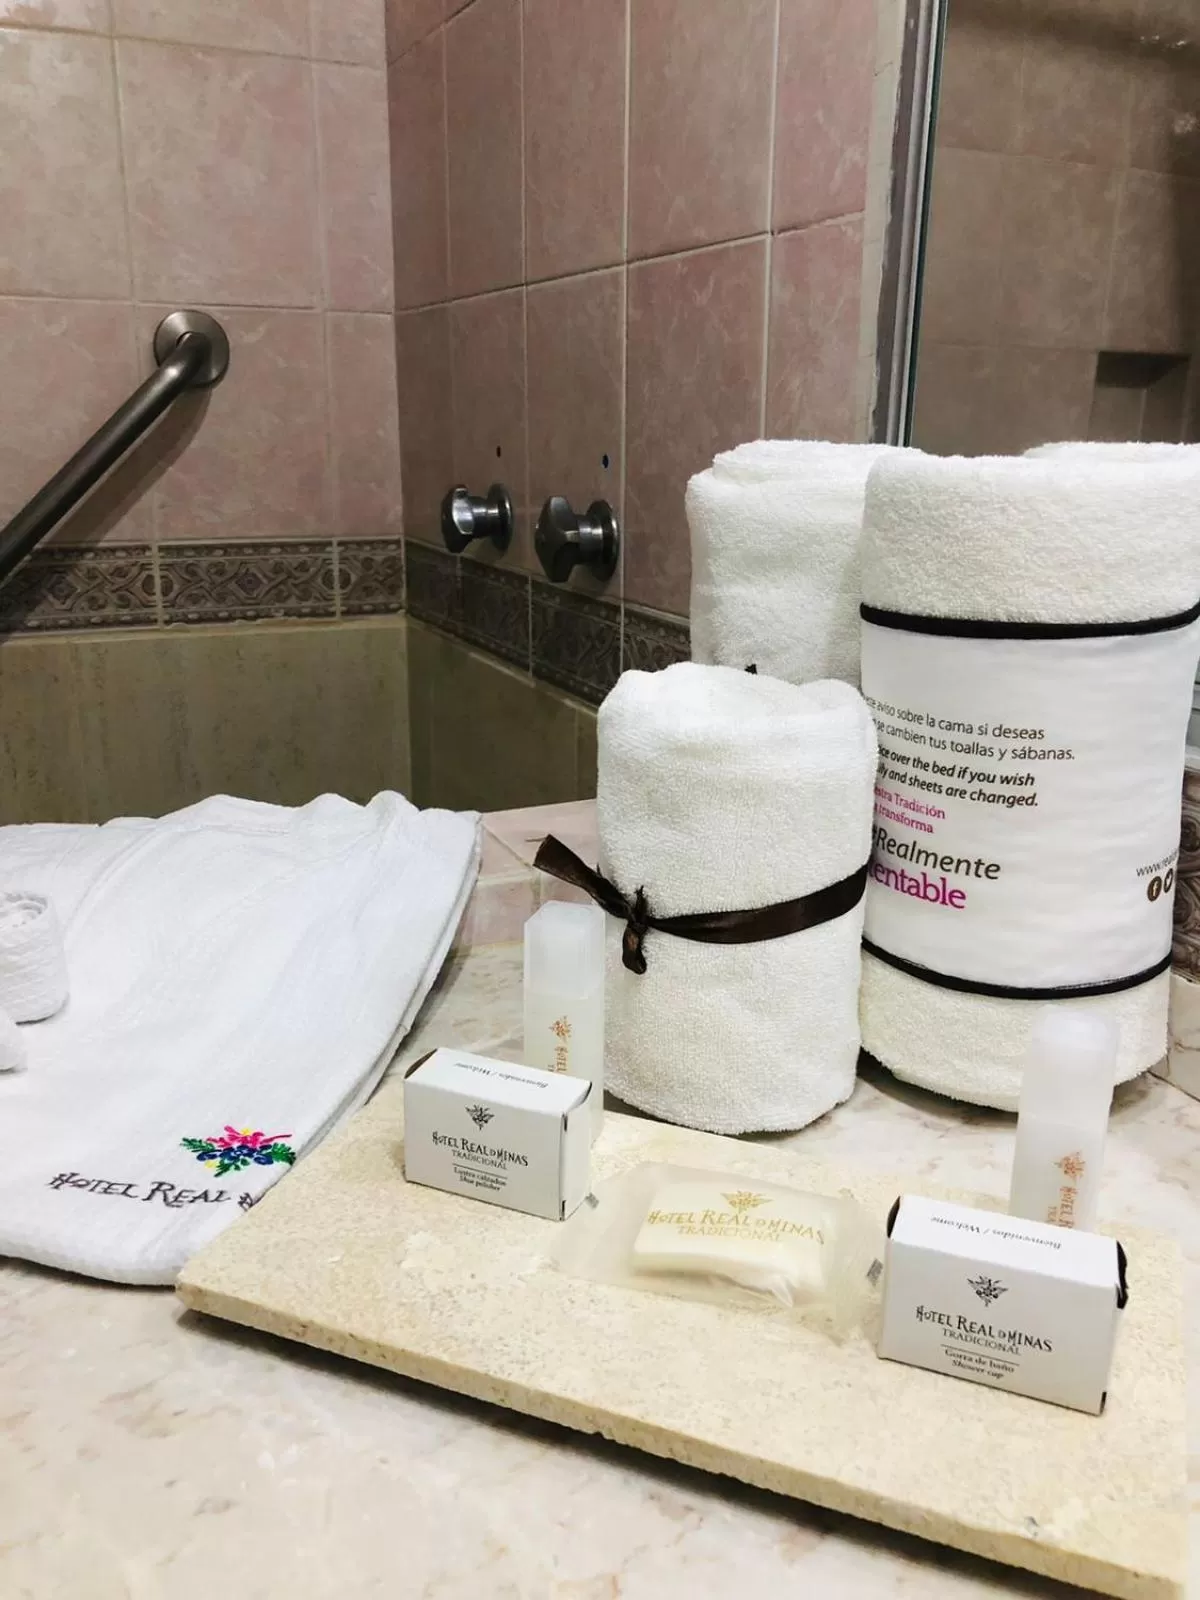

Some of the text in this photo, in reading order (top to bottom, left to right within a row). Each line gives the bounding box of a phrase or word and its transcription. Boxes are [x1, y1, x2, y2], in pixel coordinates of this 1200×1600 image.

[897, 708, 924, 725] sobre
[926, 712, 936, 728] la
[938, 719, 973, 735] cama
[978, 722, 988, 736] si
[992, 724, 1044, 740] deseas
[886, 724, 927, 745] cambien
[929, 736, 947, 750] tus
[950, 740, 994, 758] toallas
[998, 747, 1008, 761] y
[1011, 745, 1075, 761] sábanas.
[890, 751, 911, 765] over
[912, 756, 930, 772] the
[932, 760, 956, 777] bed
[957, 766, 969, 779] if
[968, 770, 996, 784] you
[1000, 773, 1035, 787] wish
[888, 770, 908, 784] and
[908, 775, 943, 795] sheets
[945, 786, 967, 799] are
[969, 788, 1039, 808] changed.
[879, 804, 935, 834] transforma
[894, 793, 945, 819] Tradición
[432, 1131, 459, 1149] HOTEL
[461, 1138, 489, 1157] REAL
[451, 1149, 508, 1171] TRADICIONAL
[48, 1171, 140, 1199] HOTEL
[142, 1181, 232, 1208] REAL
[648, 1209, 696, 1225] HOTEL
[701, 1208, 751, 1226] REAL
[931, 1216, 980, 1234] Welcome
[677, 1226, 785, 1243] TRADICIONAL
[992, 1229, 1061, 1249] Bienvenidos
[915, 1304, 953, 1328] HOTEL
[956, 1314, 995, 1338] REAL
[943, 1327, 1021, 1356] TRADICIONAL
[945, 1348, 1015, 1374] Gorra de baño
[951, 1358, 985, 1374] Shower
